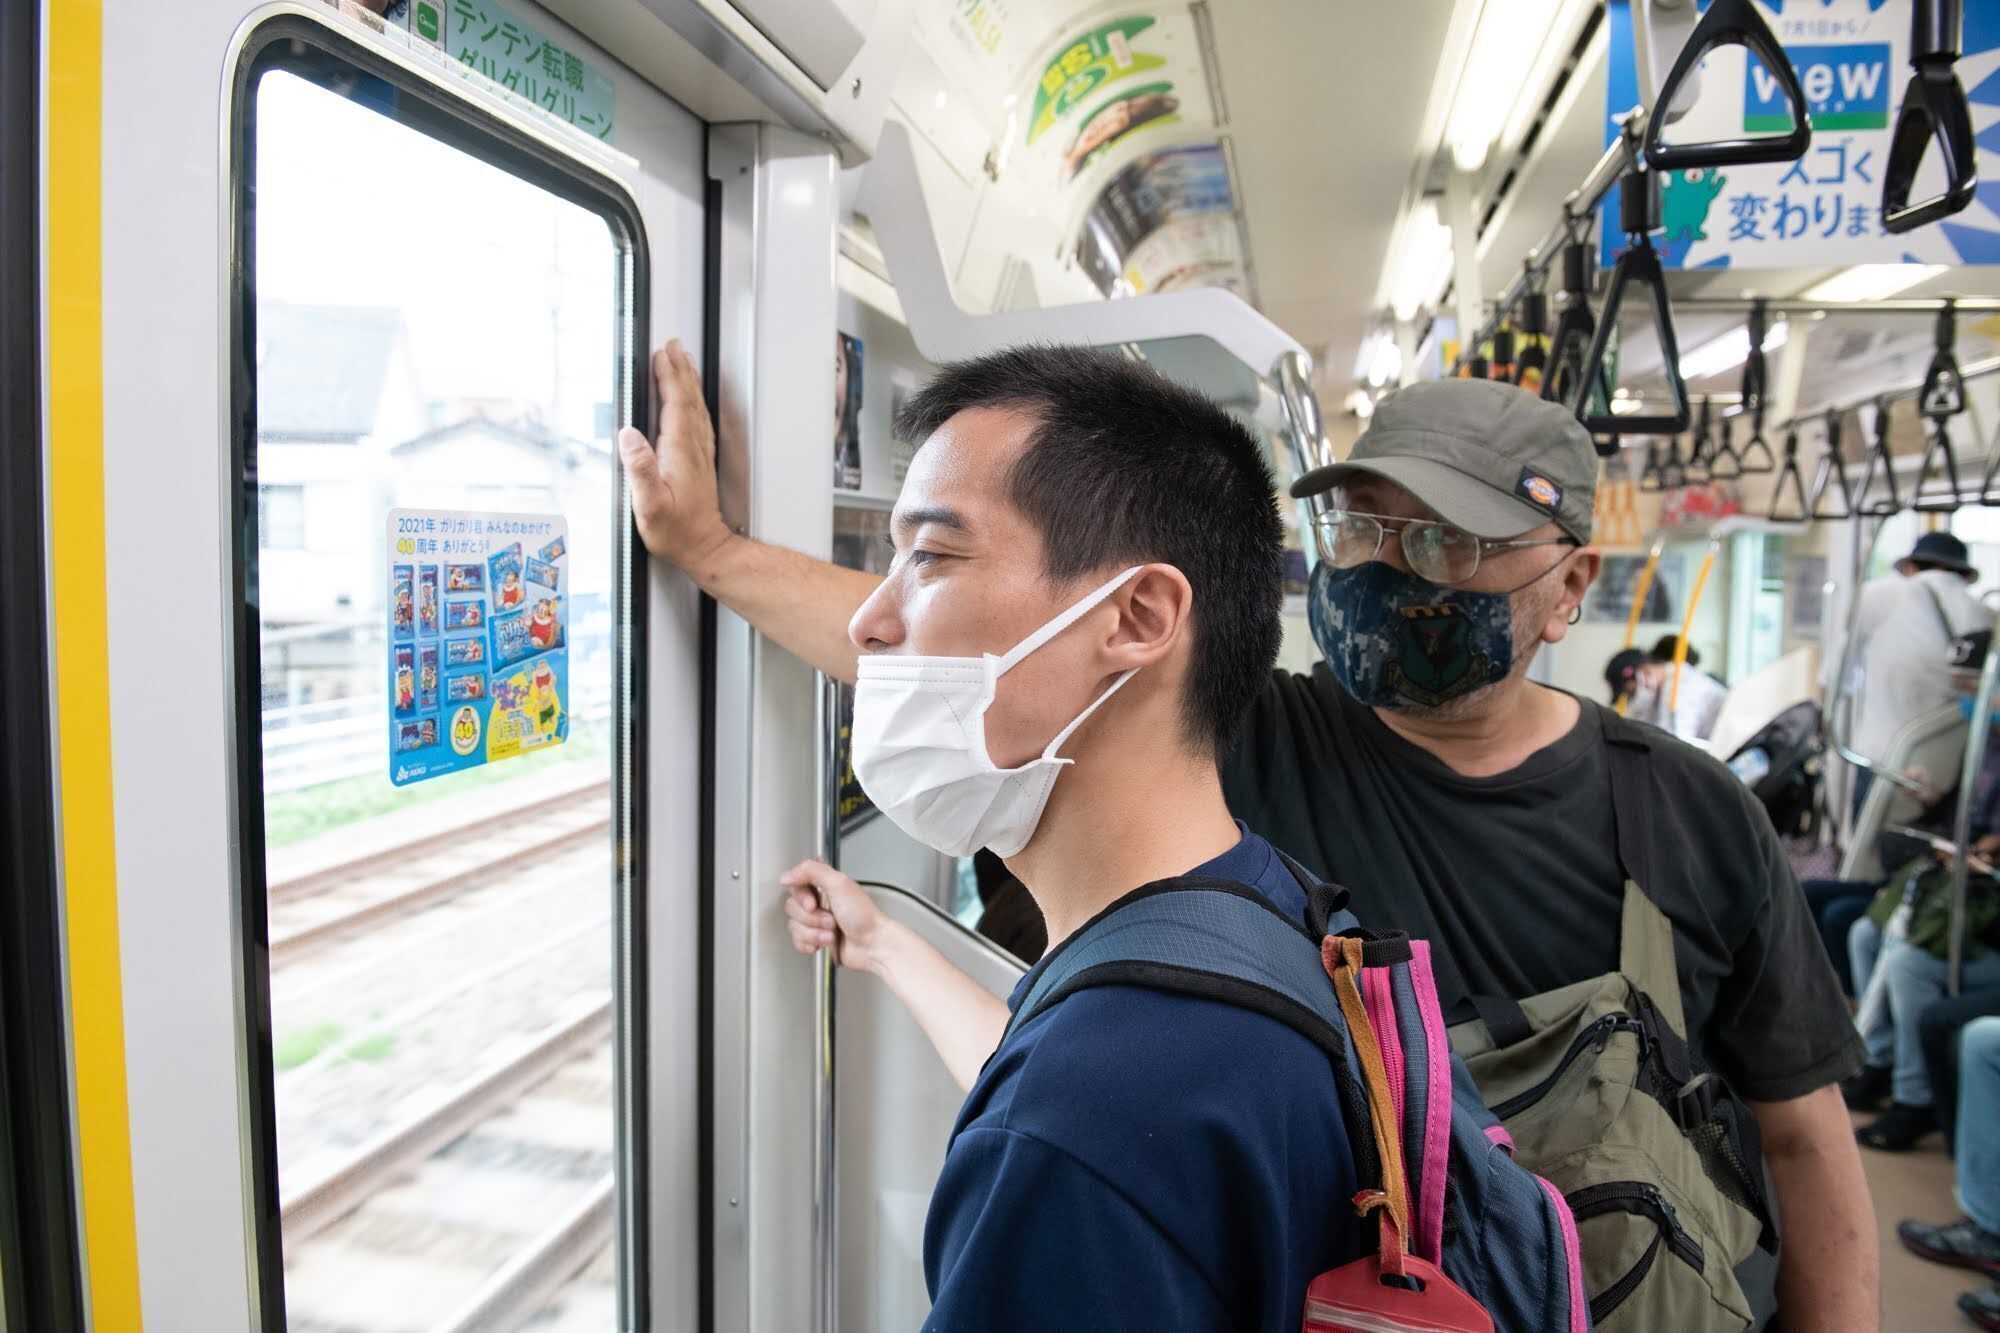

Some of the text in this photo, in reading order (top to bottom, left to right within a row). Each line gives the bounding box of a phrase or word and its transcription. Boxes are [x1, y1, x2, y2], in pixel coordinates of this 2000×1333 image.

[453, 0, 585, 93] テンテン転職
[1751, 62, 1884, 104] vew
[398, 517, 436, 533] 2021年
[396, 537, 439, 556] 40周年
